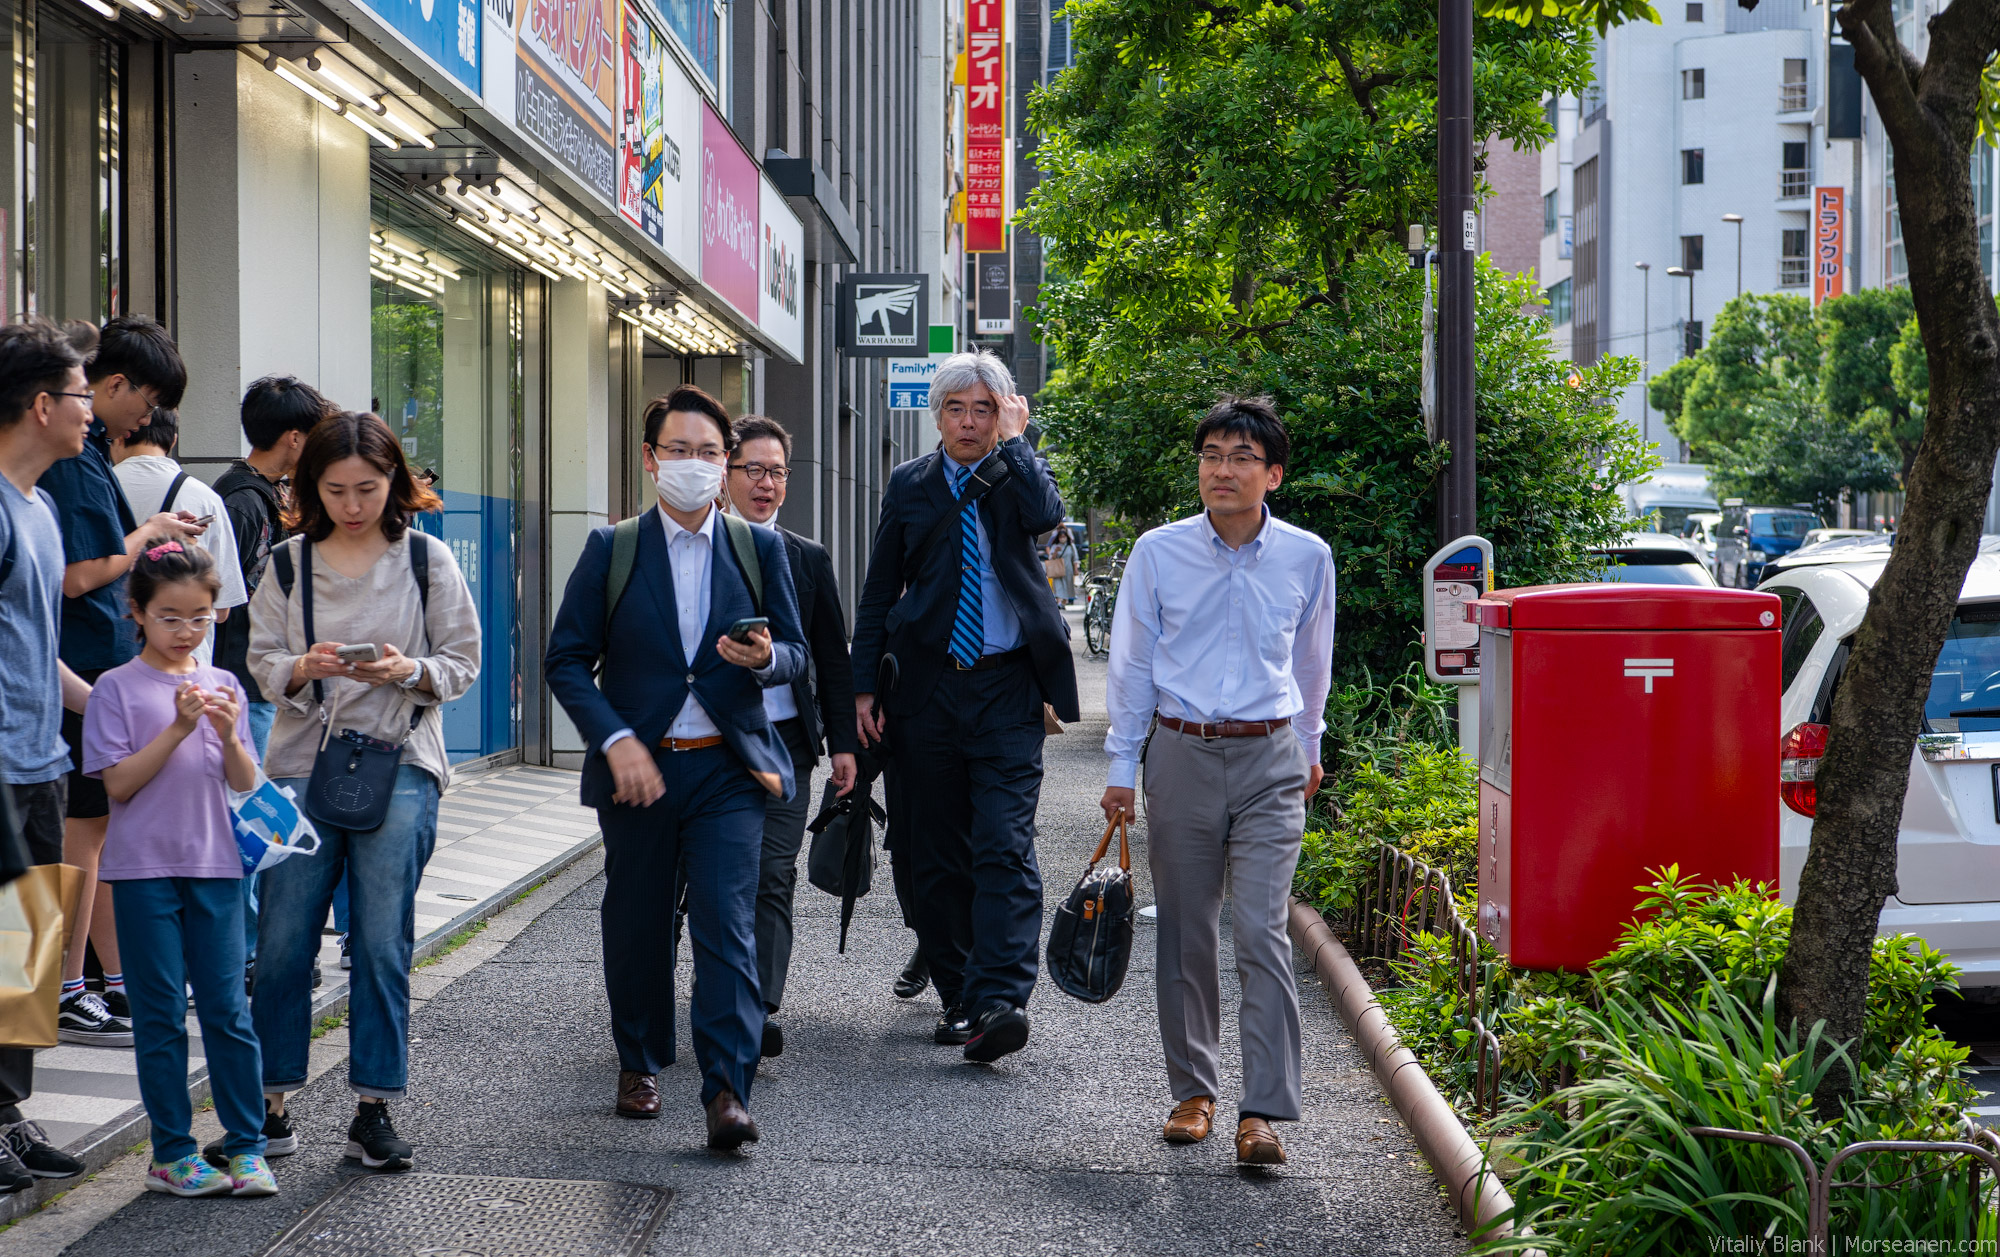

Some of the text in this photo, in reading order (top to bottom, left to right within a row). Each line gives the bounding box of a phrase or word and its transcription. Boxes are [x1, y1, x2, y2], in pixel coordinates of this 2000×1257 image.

[970, 0, 999, 109] ーディオ
[968, 178, 1001, 188] アナログ
[968, 193, 1001, 203] 中古品
[858, 336, 916, 344] WARHAMMER
[896, 392, 911, 407] 酒
[444, 538, 477, 583] 葉原店
